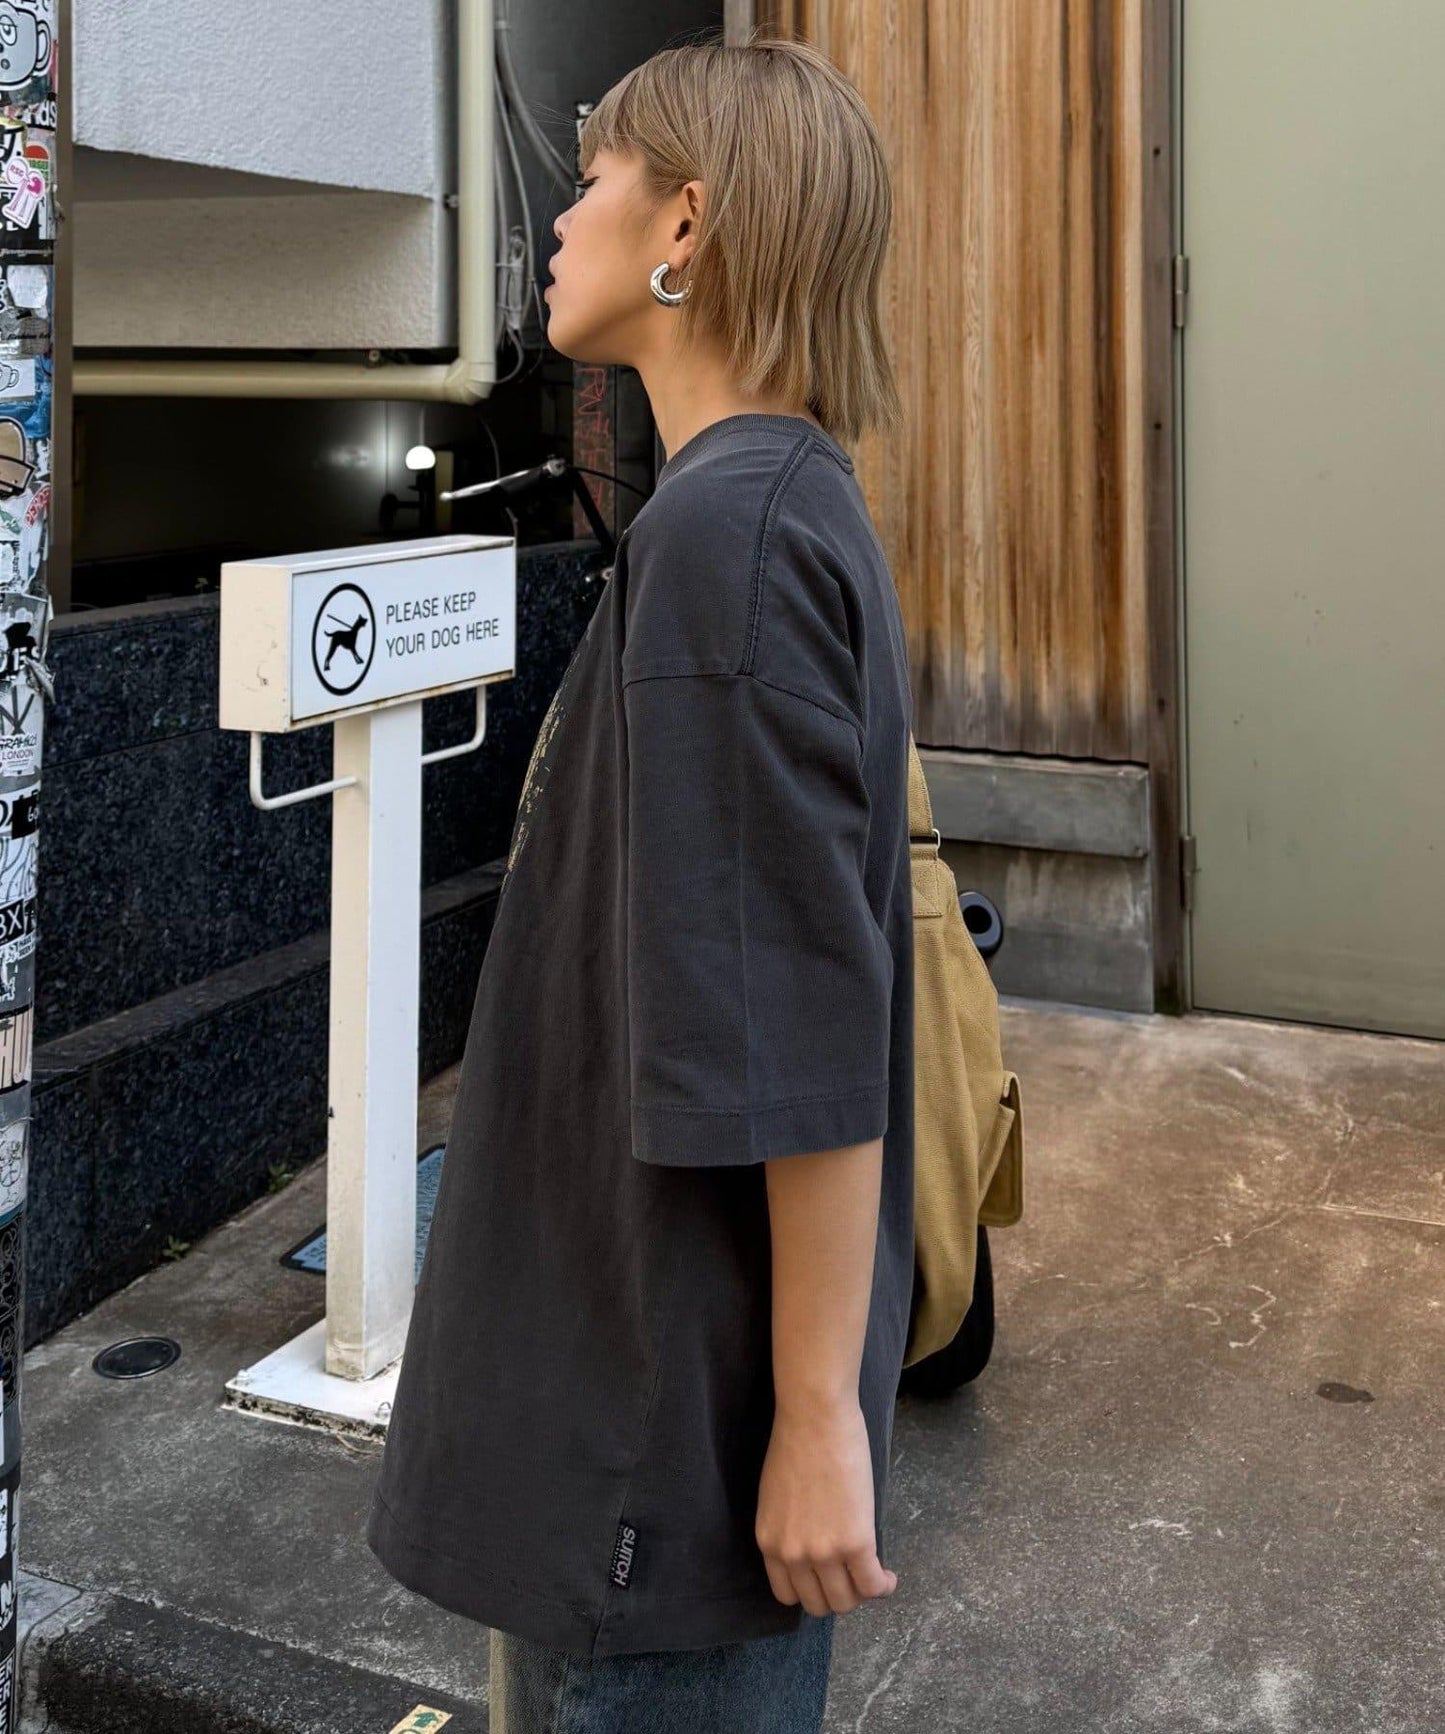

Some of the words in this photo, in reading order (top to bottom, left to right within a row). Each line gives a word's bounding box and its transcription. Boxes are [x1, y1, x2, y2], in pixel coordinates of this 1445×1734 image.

[386, 597, 439, 625] PLEASE
[444, 591, 476, 615] KEEP
[386, 633, 425, 658] YOUR
[431, 625, 460, 649] DOG
[466, 618, 499, 643] HERE
[2, 748, 34, 760] LONDON
